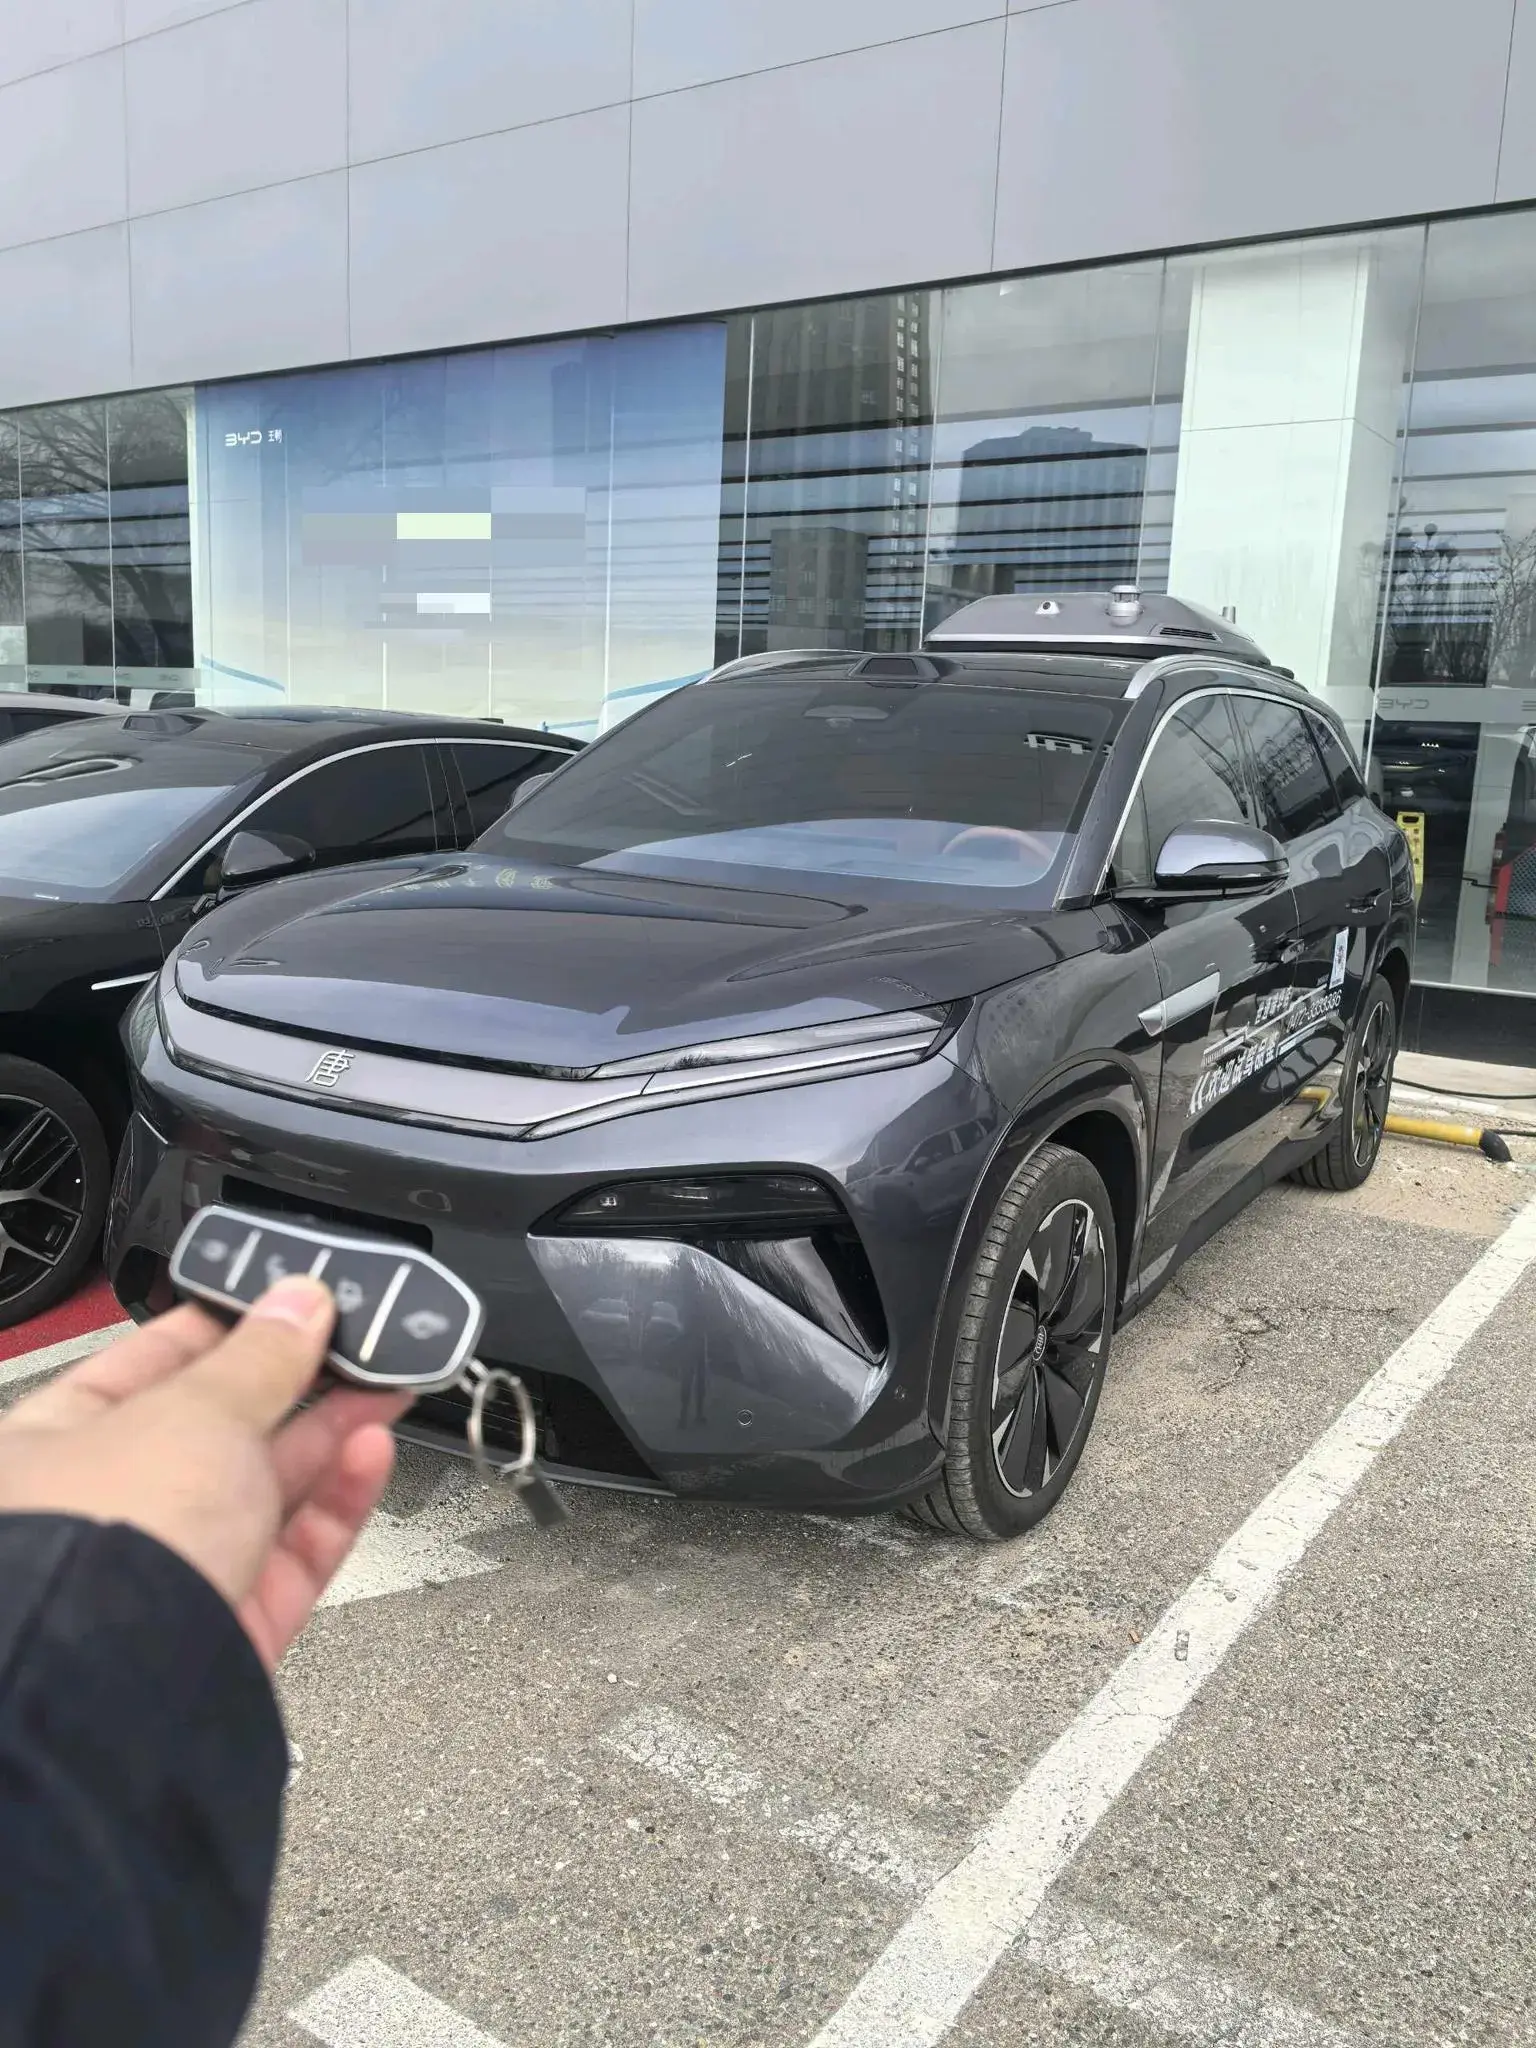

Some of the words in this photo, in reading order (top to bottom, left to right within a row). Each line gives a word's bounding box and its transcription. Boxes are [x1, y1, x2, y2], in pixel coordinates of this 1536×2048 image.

[225, 430, 262, 447] BYD
[1379, 698, 1430, 710] BYD
[305, 1049, 355, 1087] 唐
